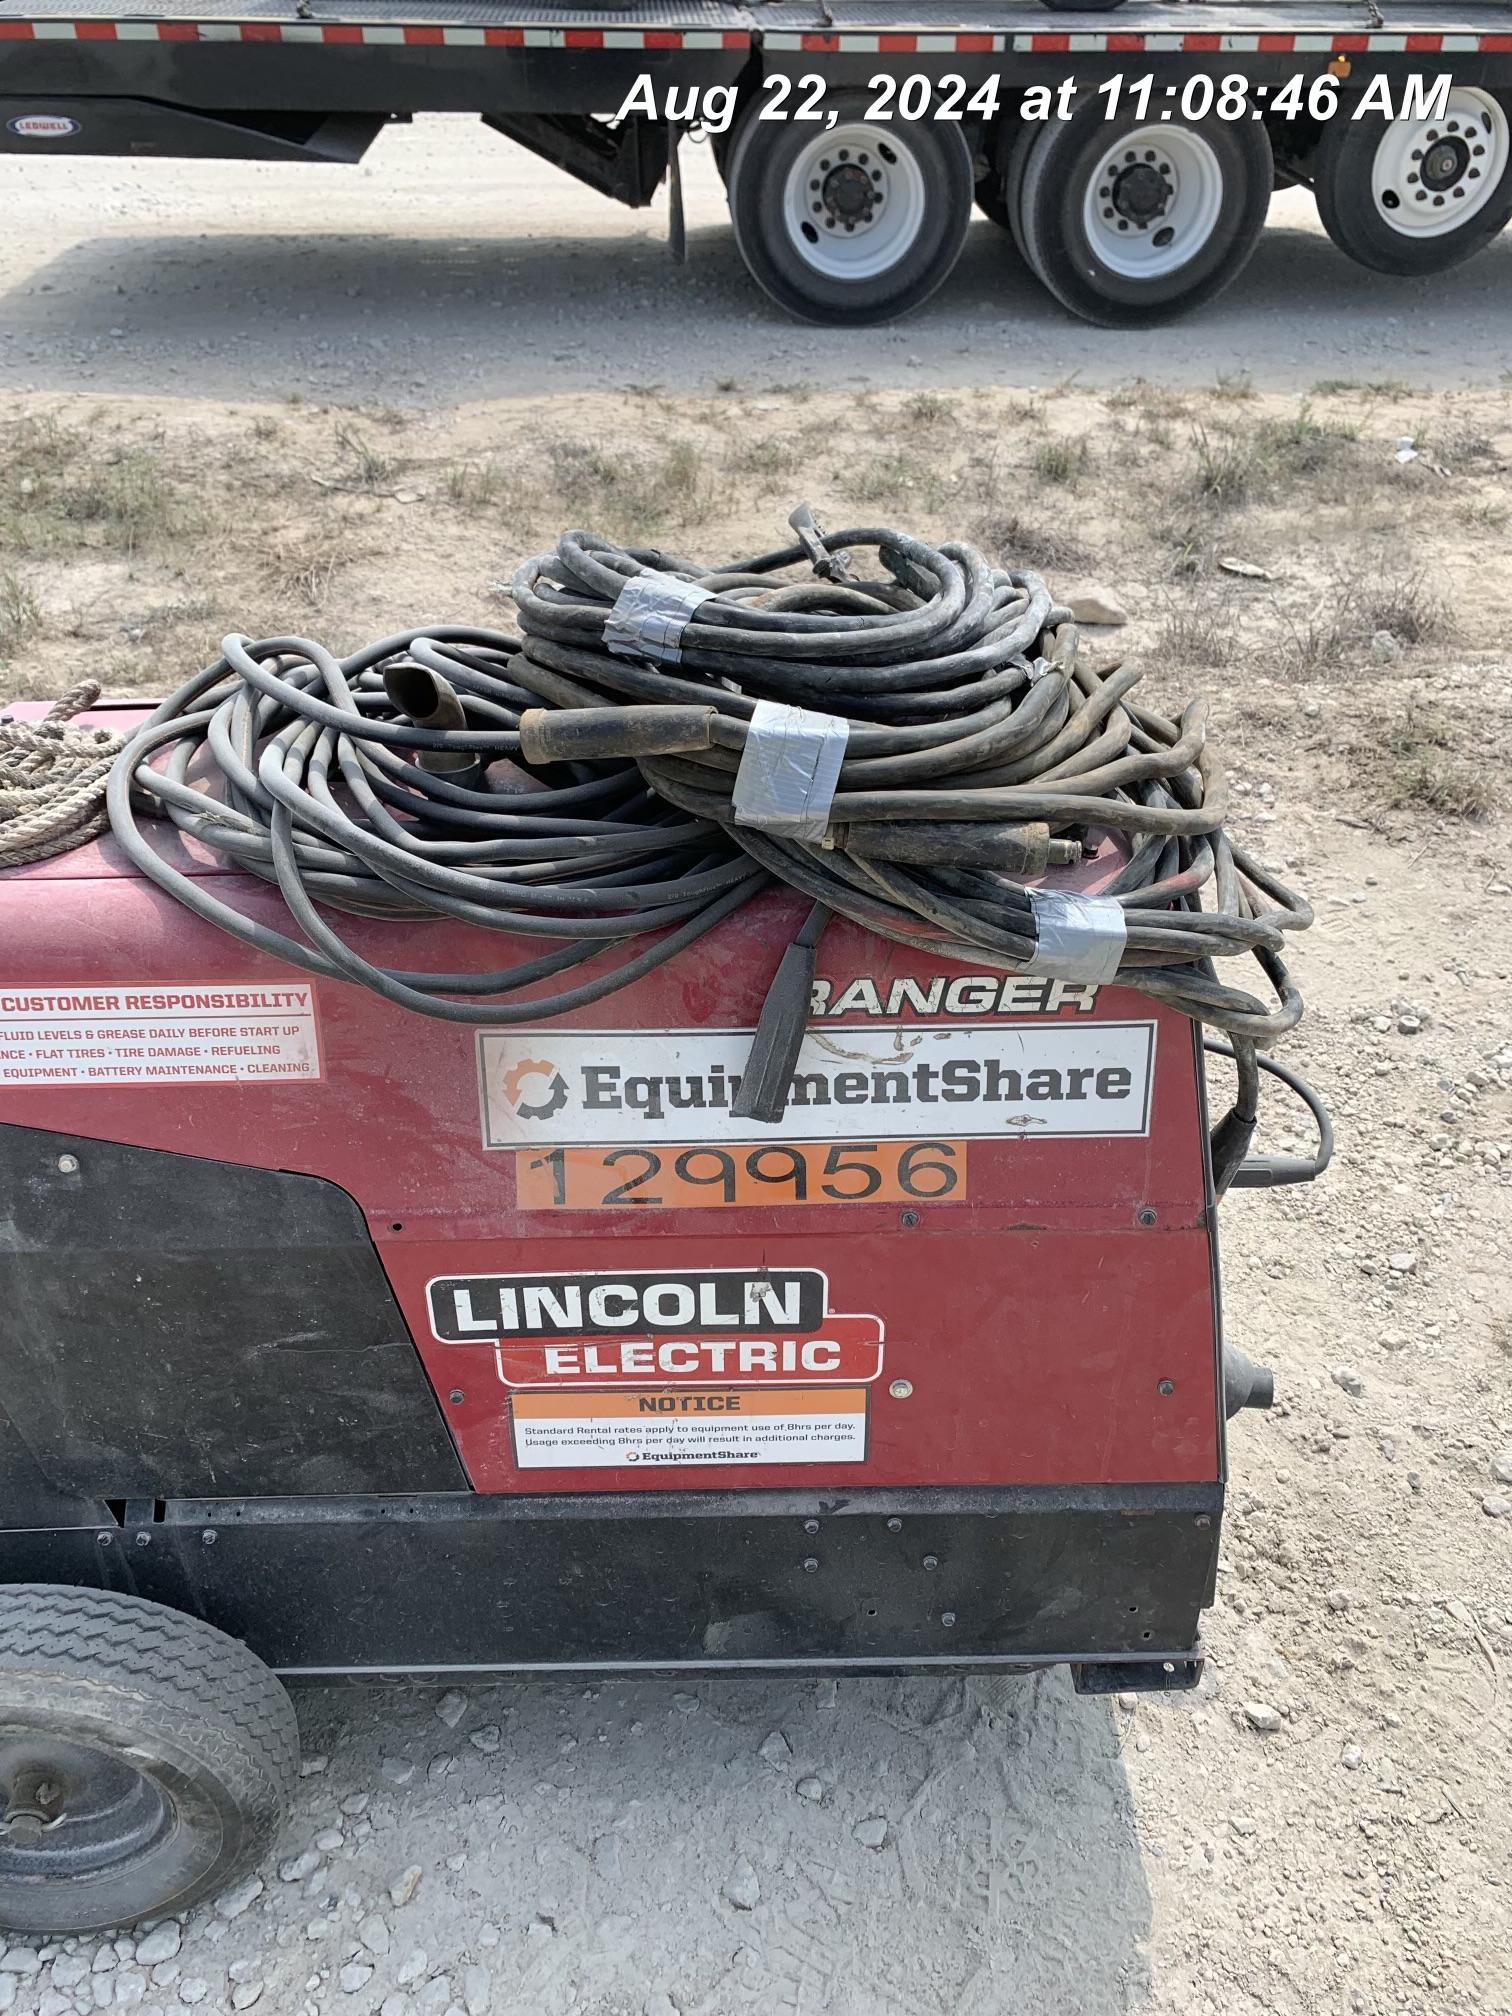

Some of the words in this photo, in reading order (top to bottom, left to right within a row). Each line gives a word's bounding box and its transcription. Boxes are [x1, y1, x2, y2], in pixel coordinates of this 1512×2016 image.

[1, 996, 120, 1012] CUSTOMER
[125, 992, 308, 1010] RESPONSIBILITY
[806, 976, 1100, 1015] RANGER
[37, 1030, 82, 1040] LEVELS
[85, 1030, 94, 1039] &
[97, 1029, 146, 1039] GREASE
[149, 1028, 186, 1038] DAILY
[188, 1027, 237, 1038] BEFORE
[239, 1026, 280, 1037] START
[282, 1026, 300, 1036] UP
[0, 1050, 26, 1060] NCE
[35, 1050, 64, 1059] FLAT
[67, 1049, 106, 1059] TIRES
[114, 1048, 145, 1058] TIRE
[148, 1047, 201, 1058] DAMAGE
[211, 1045, 281, 1056] REFUELING
[3, 1067, 78, 1079] EQUIPMENT
[88, 1066, 142, 1077] BATTERY
[145, 1064, 237, 1076] MAINTENANCE
[247, 1063, 310, 1073] CLEANING
[580, 1059, 1132, 1119] EquimentShare
[530, 1142, 959, 1205] 129956
[453, 1281, 801, 1332] LINCOLN
[544, 1339, 842, 1375] ELECTRIC
[638, 1396, 741, 1413] NOTICE
[525, 1427, 574, 1435] Standard
[577, 1426, 611, 1434] Rental
[614, 1426, 643, 1434] rates
[645, 1425, 674, 1434] apply
[677, 1424, 689, 1432] to
[691, 1423, 749, 1433] equipment
[773, 1423, 785, 1431] of
[814, 1423, 832, 1431] per
[834, 1421, 856, 1430] day.
[525, 1437, 558, 1447] Usage
[561, 1437, 616, 1446] exceeding
[645, 1437, 663, 1445] per
[666, 1436, 685, 1444] day
[687, 1434, 706, 1443] will
[708, 1434, 740, 1443] result
[743, 1434, 753, 1442] in
[755, 1433, 808, 1442] additional
[811, 1432, 856, 1442] charges.
[642, 1451, 759, 1461] EquipmentShare
